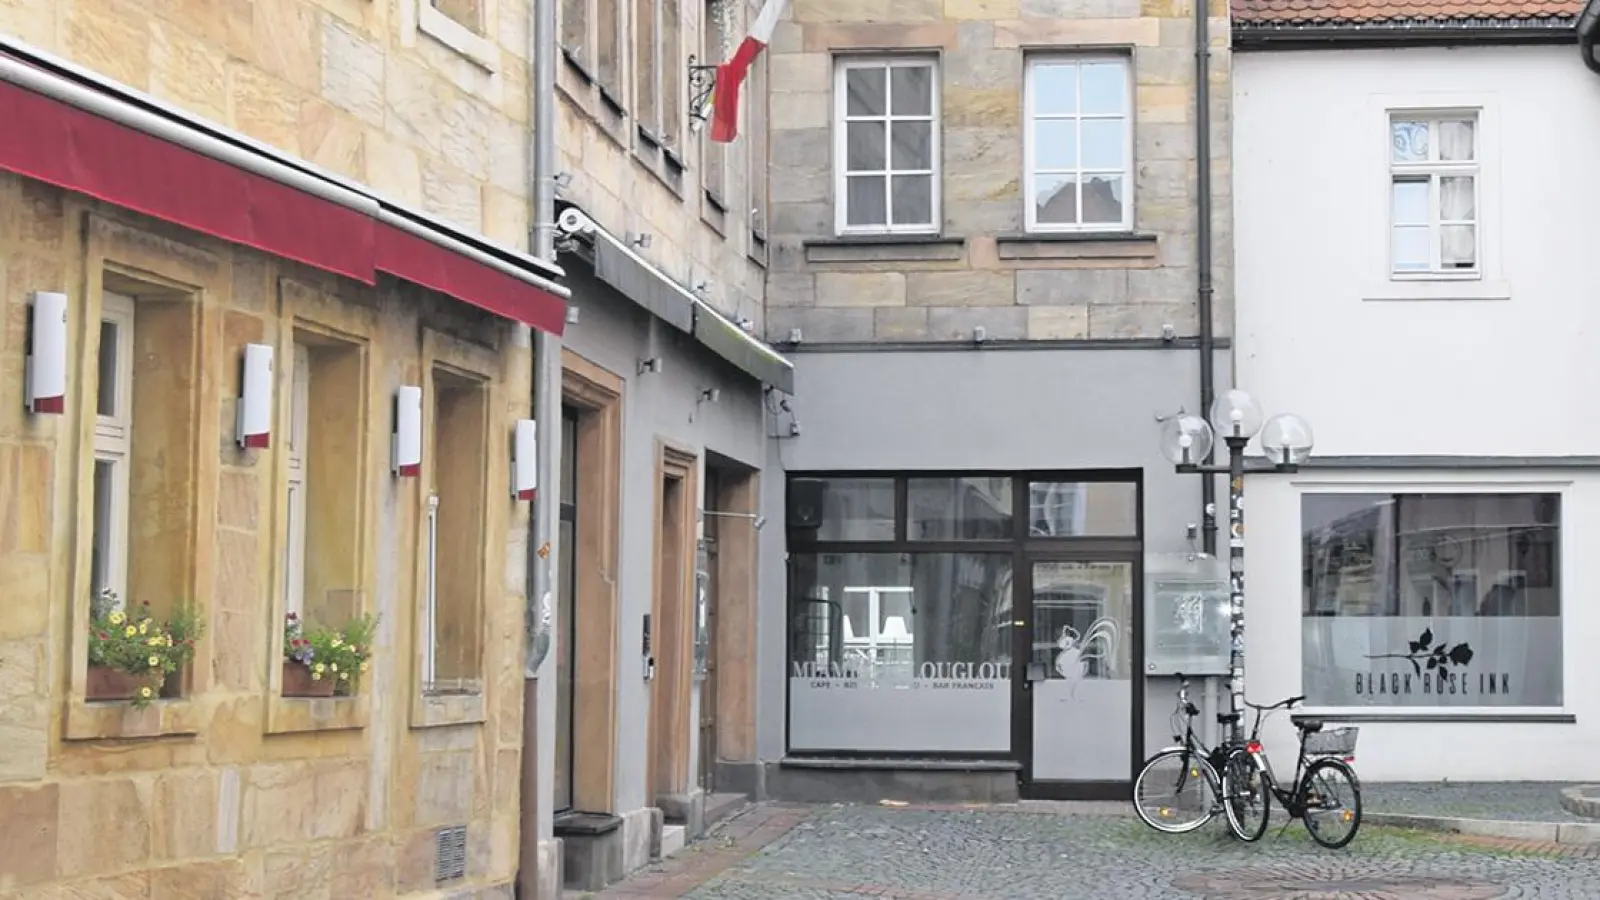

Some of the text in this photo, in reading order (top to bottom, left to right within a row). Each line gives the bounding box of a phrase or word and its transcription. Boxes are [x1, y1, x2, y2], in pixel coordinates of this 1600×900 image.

[1355, 672, 1510, 694] BLACK ROSE INK
